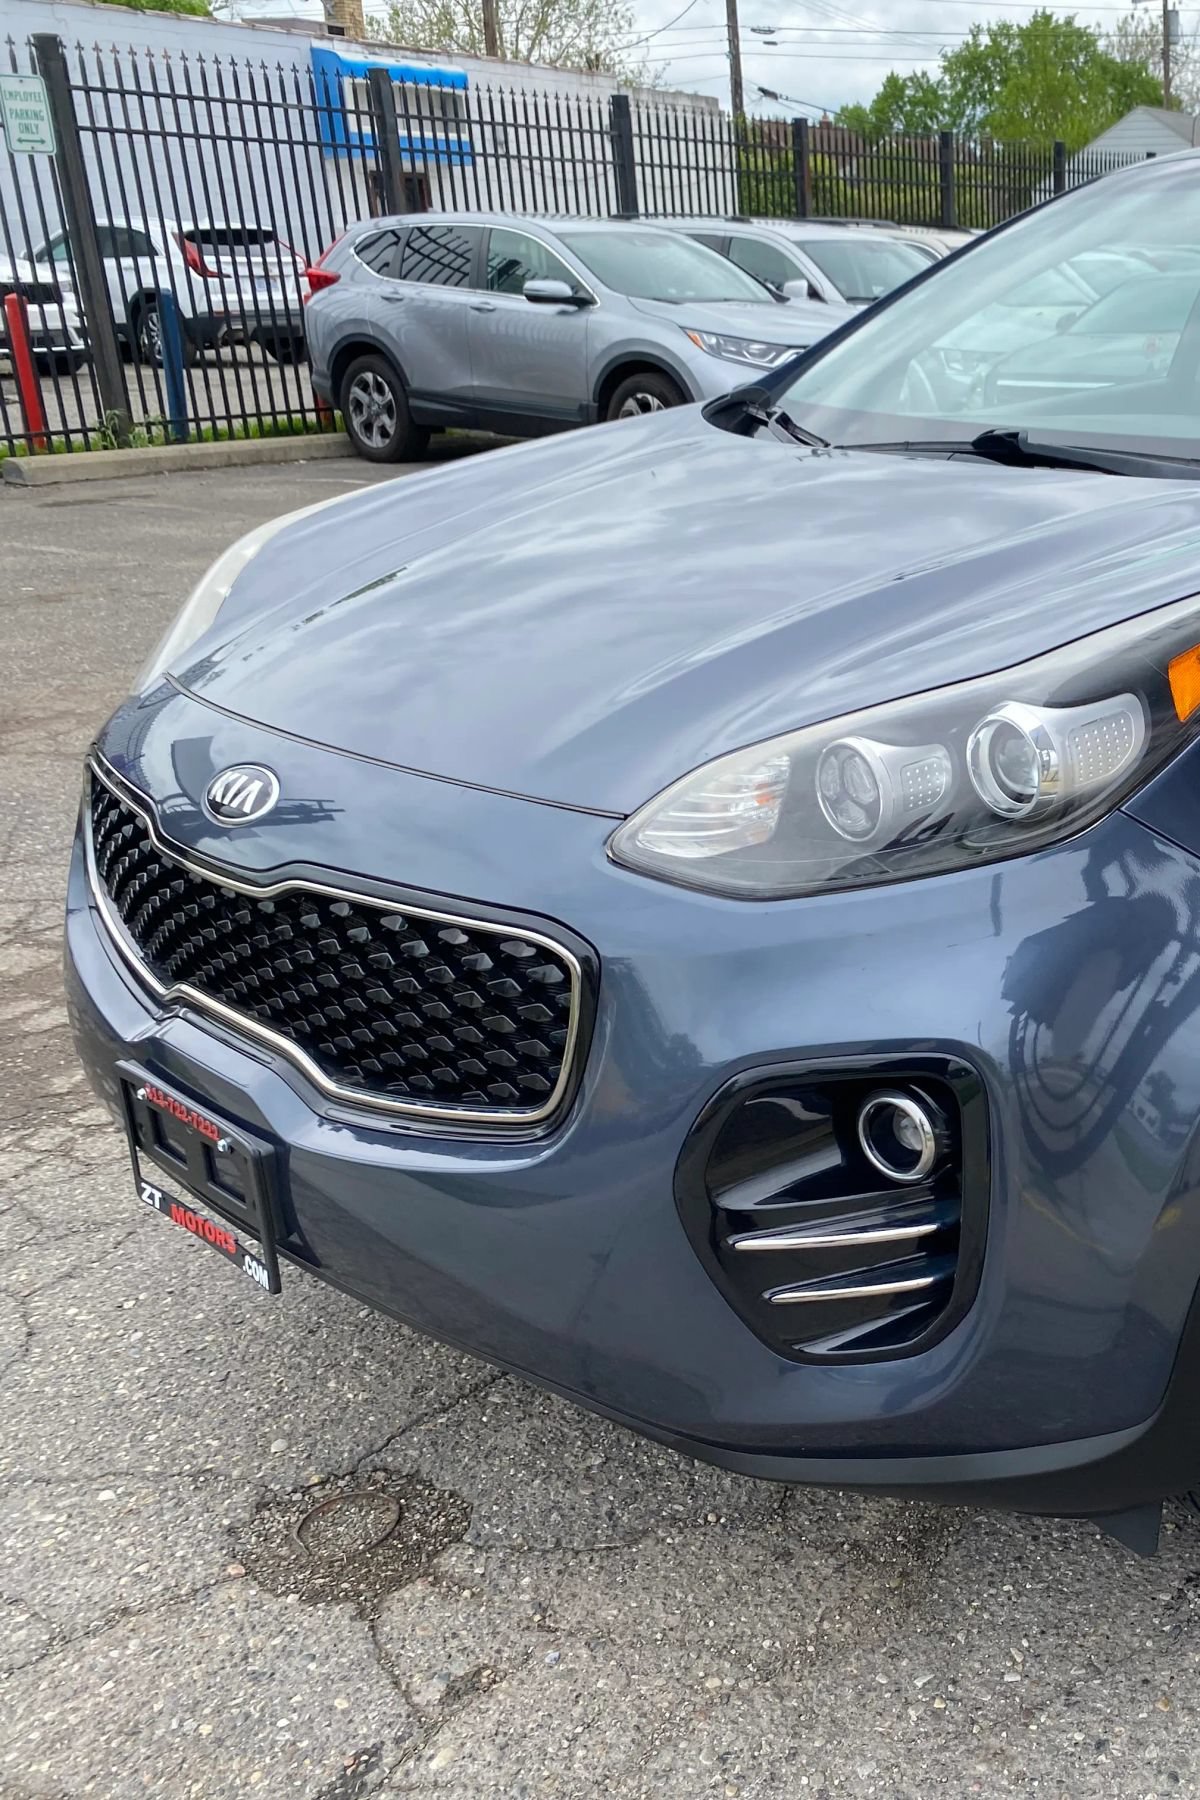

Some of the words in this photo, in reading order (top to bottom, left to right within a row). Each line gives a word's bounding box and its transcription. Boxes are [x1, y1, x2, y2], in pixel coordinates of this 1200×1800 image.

[4, 91, 42, 103] EMPLOYEE
[10, 108, 44, 121] PARKING
[19, 123, 39, 134] ONLY
[208, 771, 264, 814] KIA
[140, 1182, 163, 1210] ZT
[171, 1203, 237, 1255] MOTORS
